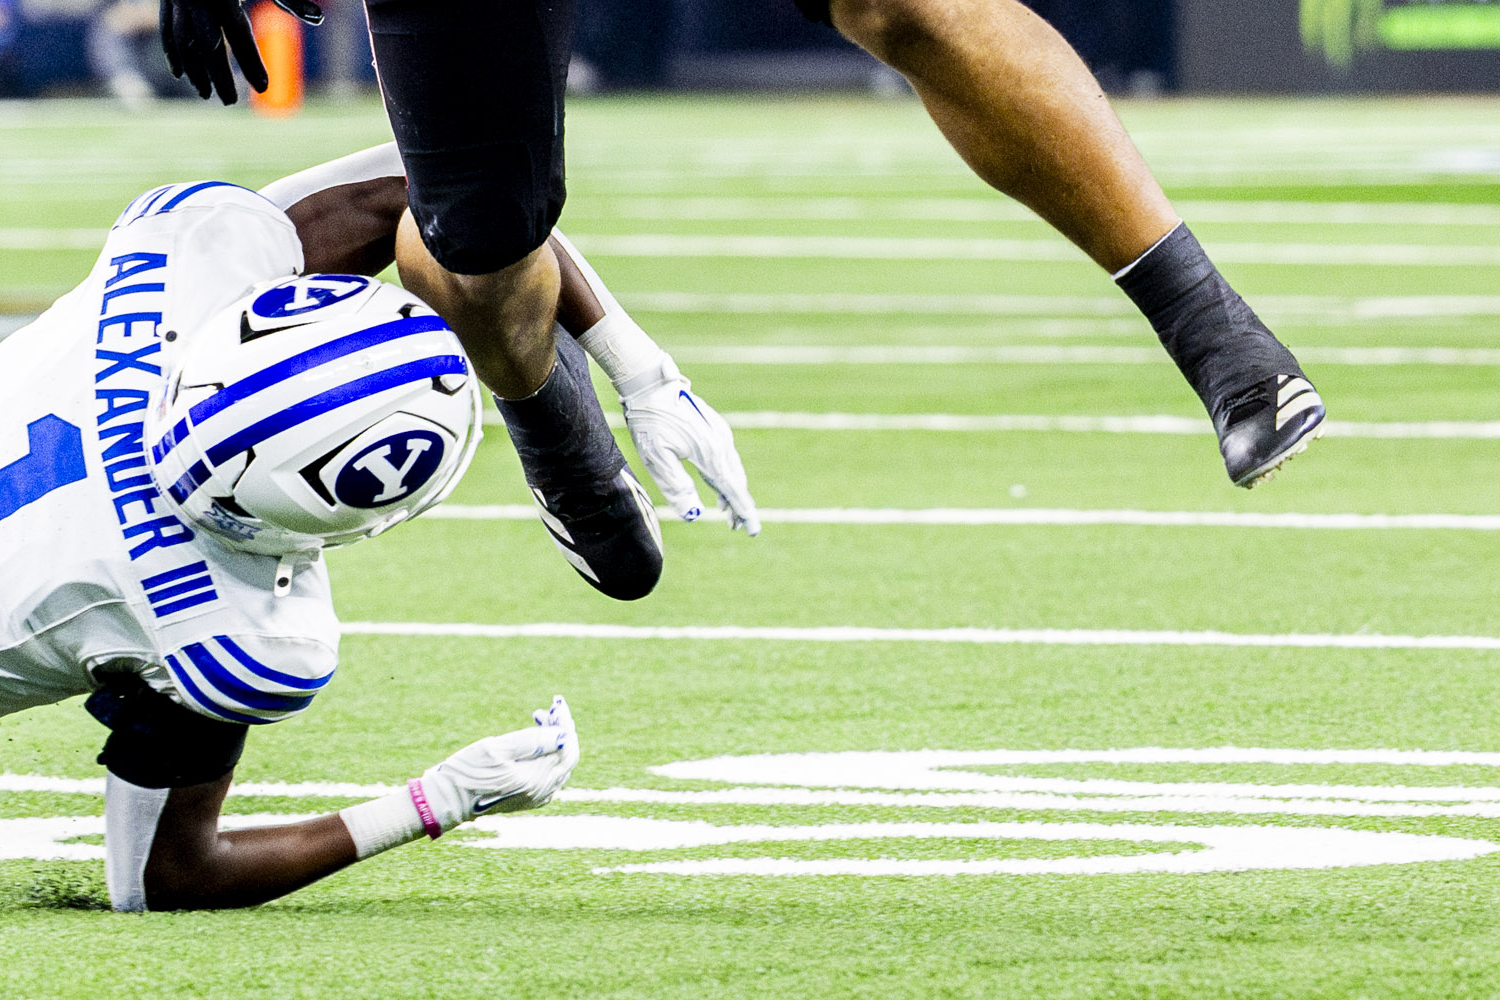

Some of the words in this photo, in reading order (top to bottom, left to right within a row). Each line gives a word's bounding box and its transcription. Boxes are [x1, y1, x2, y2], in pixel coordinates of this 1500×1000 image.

[95, 251, 195, 561] ALEXANDER
[352, 438, 433, 503] Y
[140, 559, 219, 619] III
